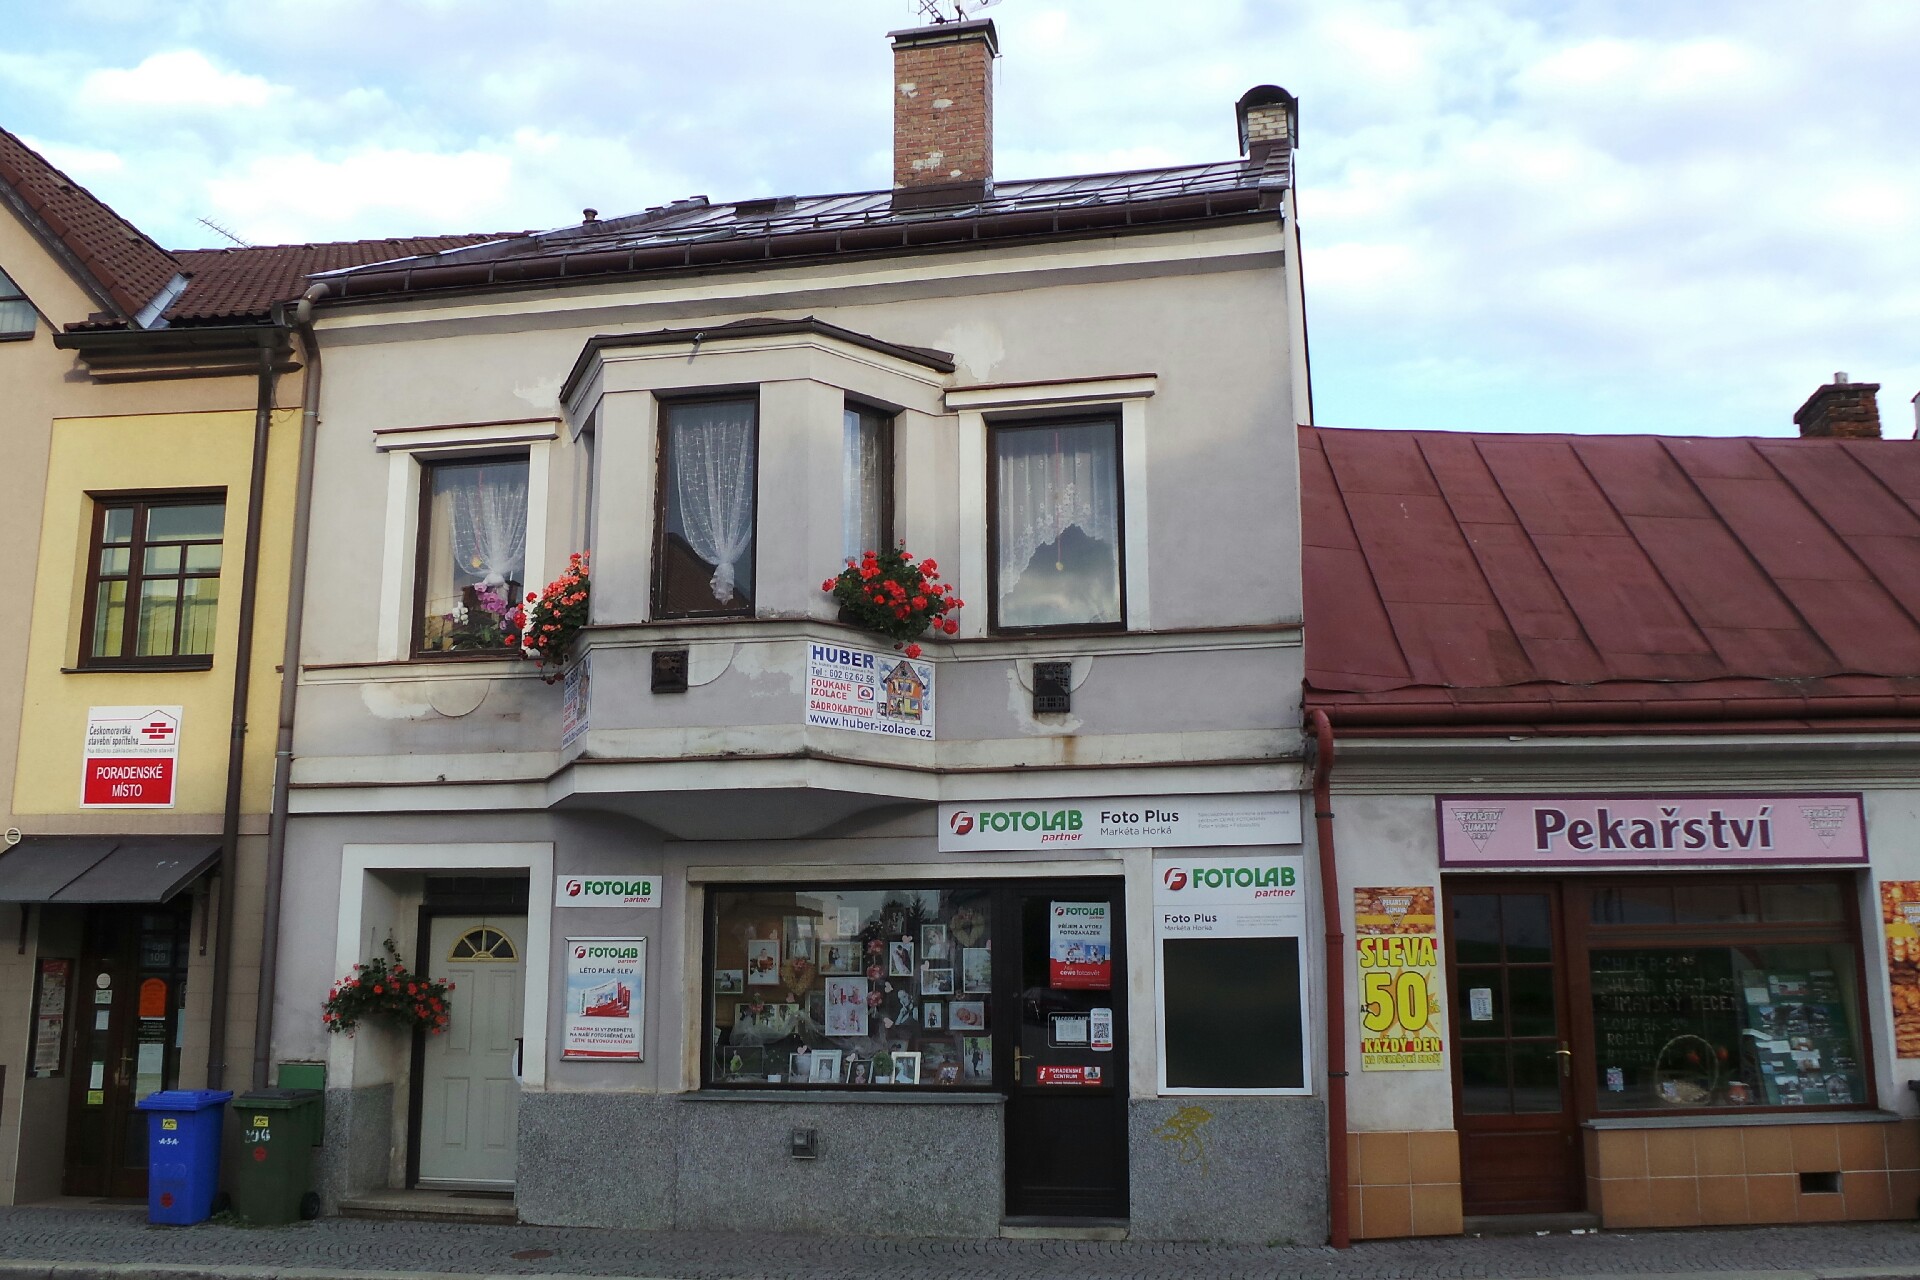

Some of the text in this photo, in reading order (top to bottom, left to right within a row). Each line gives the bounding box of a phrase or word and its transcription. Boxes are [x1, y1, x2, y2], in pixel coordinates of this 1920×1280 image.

[812, 645, 874, 669] HUBER
[829, 669, 842, 679] 602
[844, 671, 854, 681] 62
[855, 673, 864, 682] 62
[865, 675, 875, 684] 56
[811, 687, 847, 700] IZOLACE
[810, 698, 874, 717] SÁDROKARTONY
[90, 724, 131, 735] Českomoravská
[809, 714, 932, 738] www.huber-izolace.cz
[88, 736, 139, 747] stavební spořitelna
[97, 763, 164, 779] PORADENSKÉ
[112, 782, 142, 797] MÍSTO
[979, 810, 1083, 833] FOTOLAB
[1100, 809, 1179, 824] Foto Plus
[1100, 825, 1172, 836] Markéta Horká
[1534, 806, 1771, 851] Pekařství
[1041, 832, 1083, 843] partner
[1192, 866, 1296, 889] FOTOLAB
[584, 881, 651, 896] FOTOLAB
[1254, 889, 1296, 898] partner
[1066, 907, 1105, 916] FOTOLAB
[1164, 913, 1217, 923] Foto Plus
[588, 947, 638, 958] FOTOLAB
[1360, 936, 1437, 968] SLEVA
[1363, 970, 1428, 1033] 50
[1364, 1034, 1440, 1054] KAŽDÝ DEN
